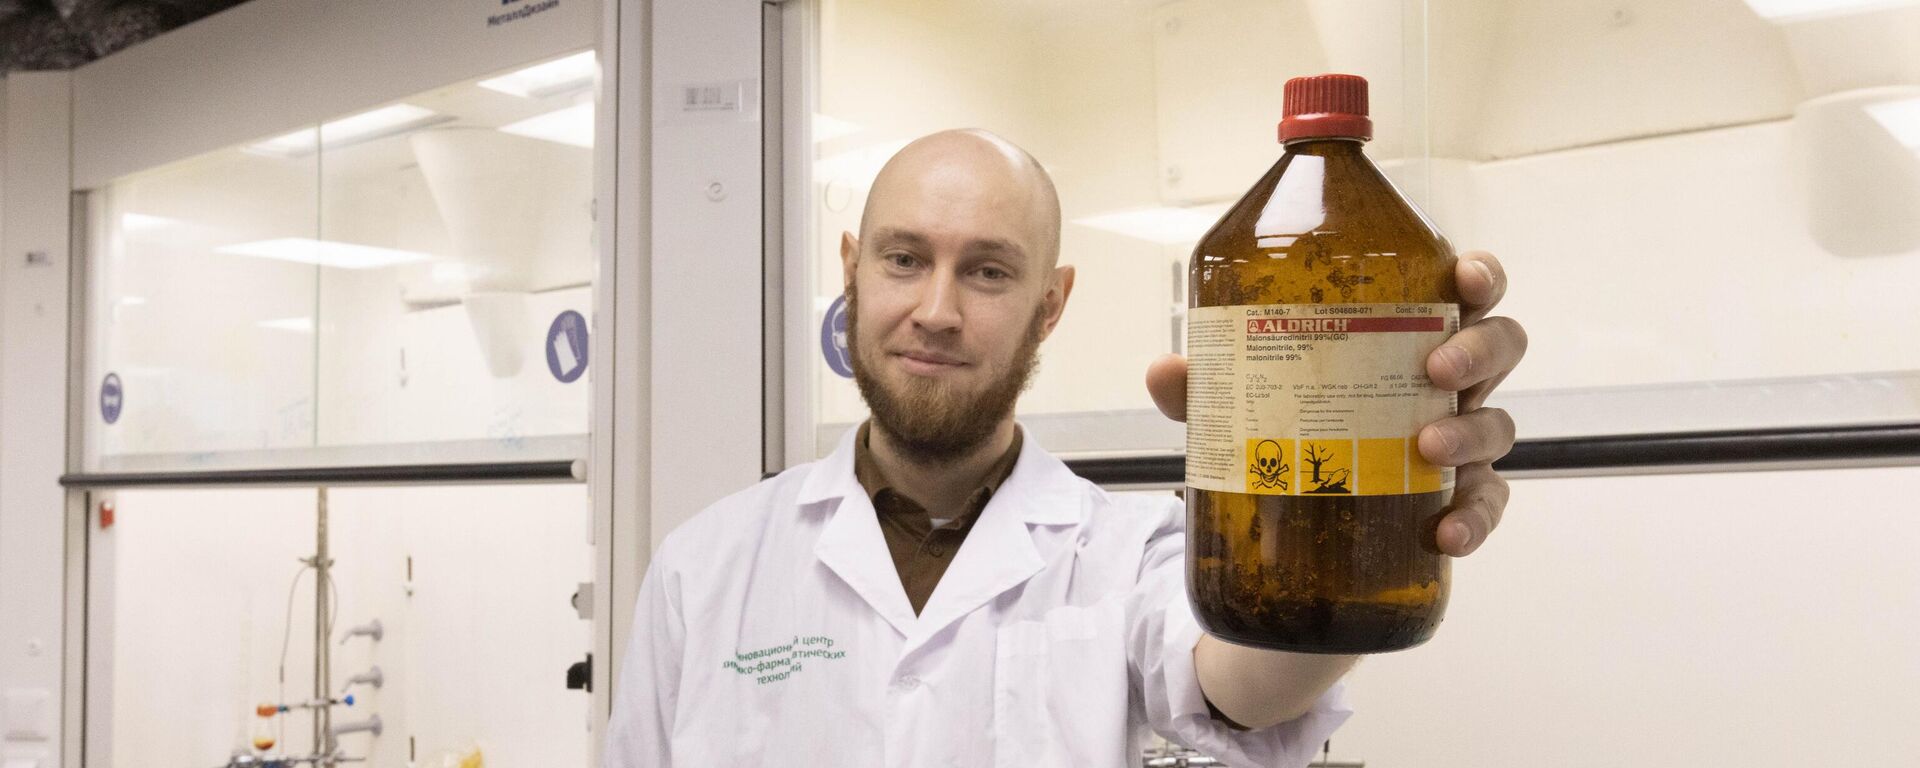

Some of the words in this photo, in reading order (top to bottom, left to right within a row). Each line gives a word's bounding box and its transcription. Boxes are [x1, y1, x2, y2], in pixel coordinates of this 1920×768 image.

[1264, 308, 1290, 316] M140-7
[1315, 307, 1328, 315] Lot
[1262, 319, 1348, 332] ALDRICH
[802, 636, 833, 648] центр
